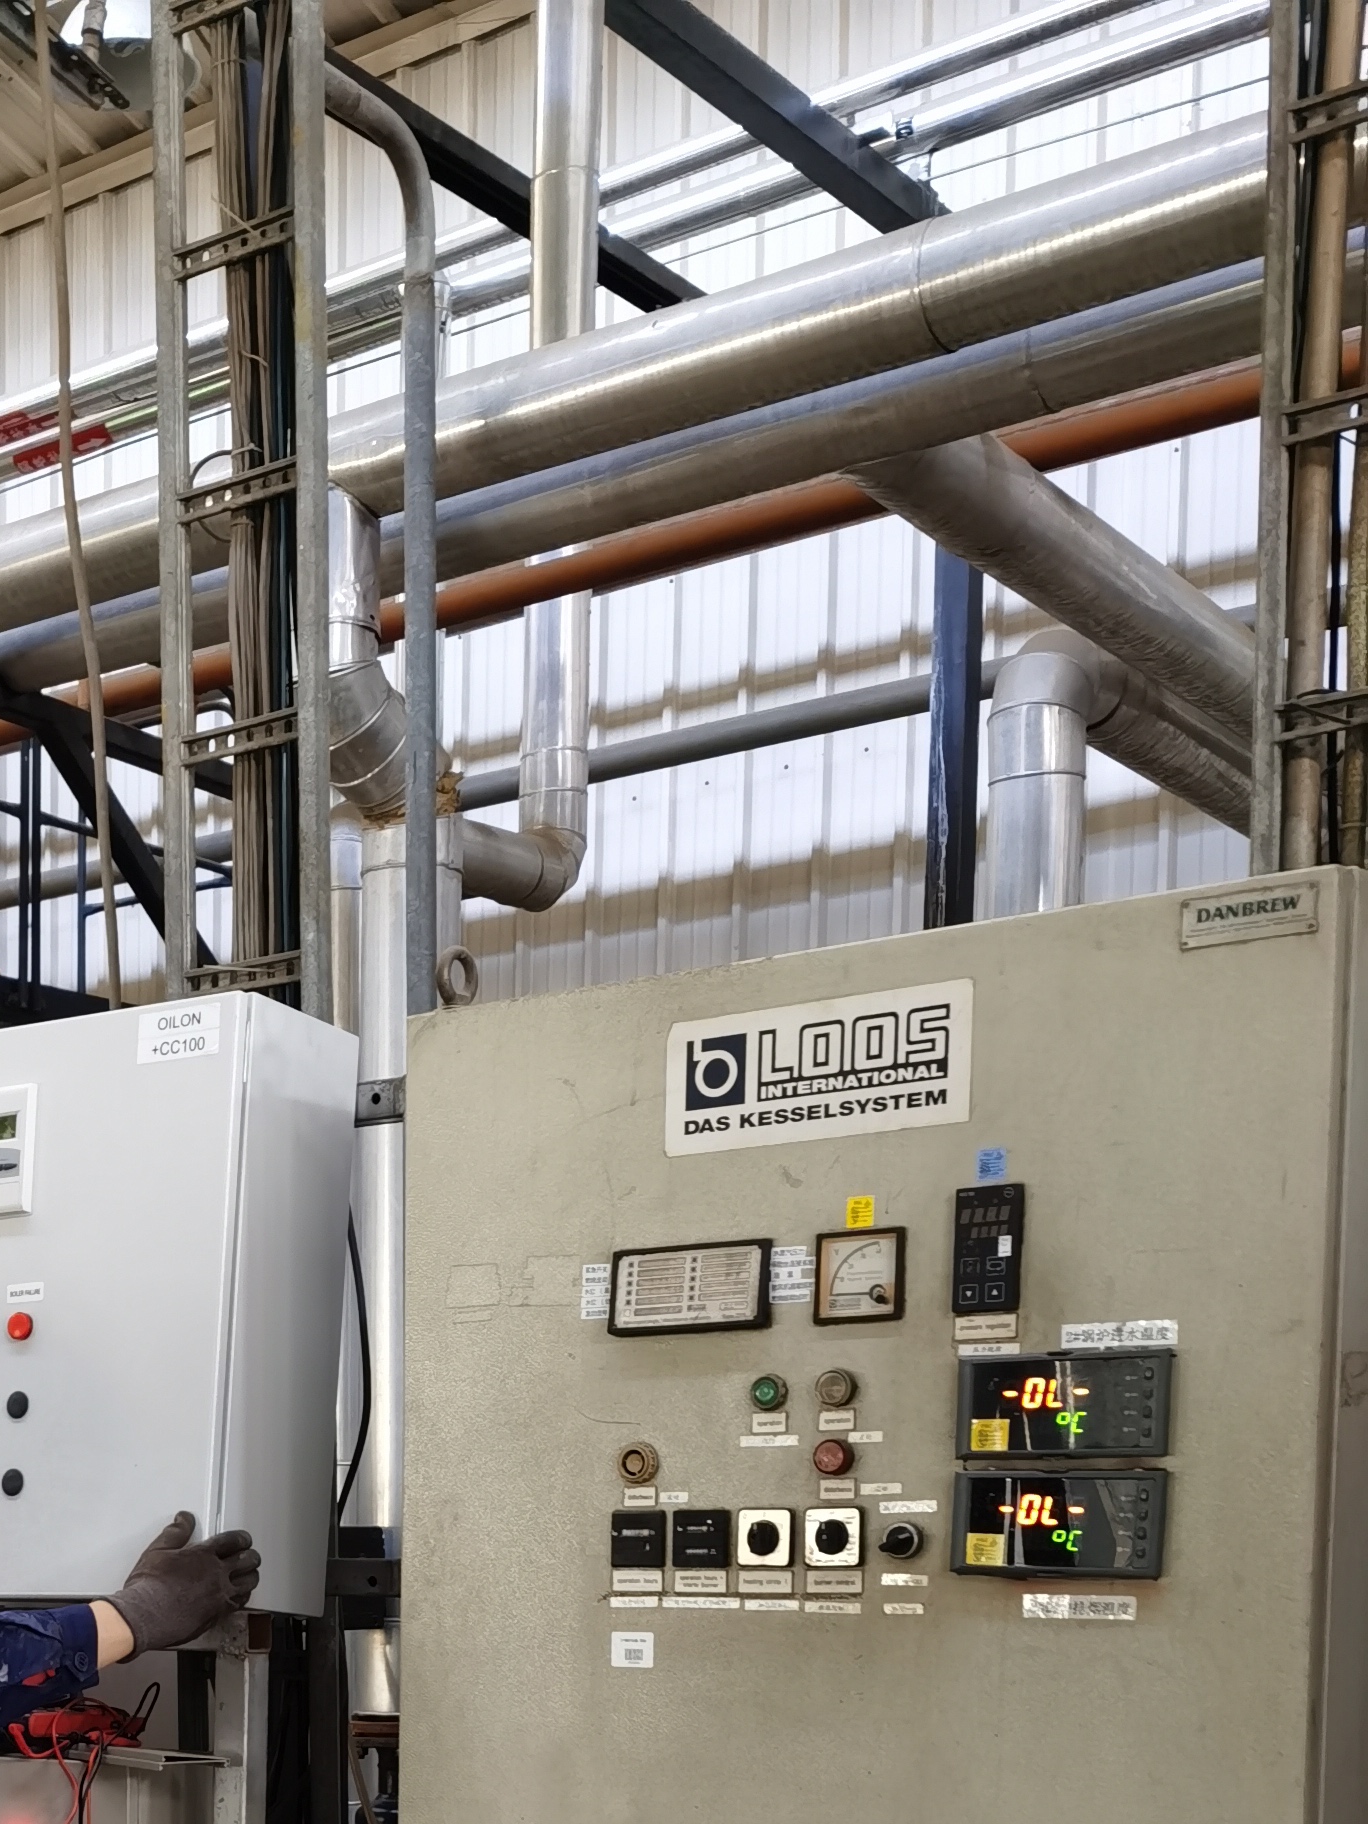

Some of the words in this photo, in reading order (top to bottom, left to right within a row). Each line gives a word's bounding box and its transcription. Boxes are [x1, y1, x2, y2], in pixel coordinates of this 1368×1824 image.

[1196, 894, 1301, 923] DANBREW
[158, 1011, 202, 1031] OILON
[152, 1036, 206, 1056] +CC100
[758, 1003, 950, 1083] LOOS
[760, 1064, 945, 1100] INTERNATIONAL
[684, 1115, 731, 1136] DAS
[739, 1089, 948, 1129] KESSELSYSTEM
